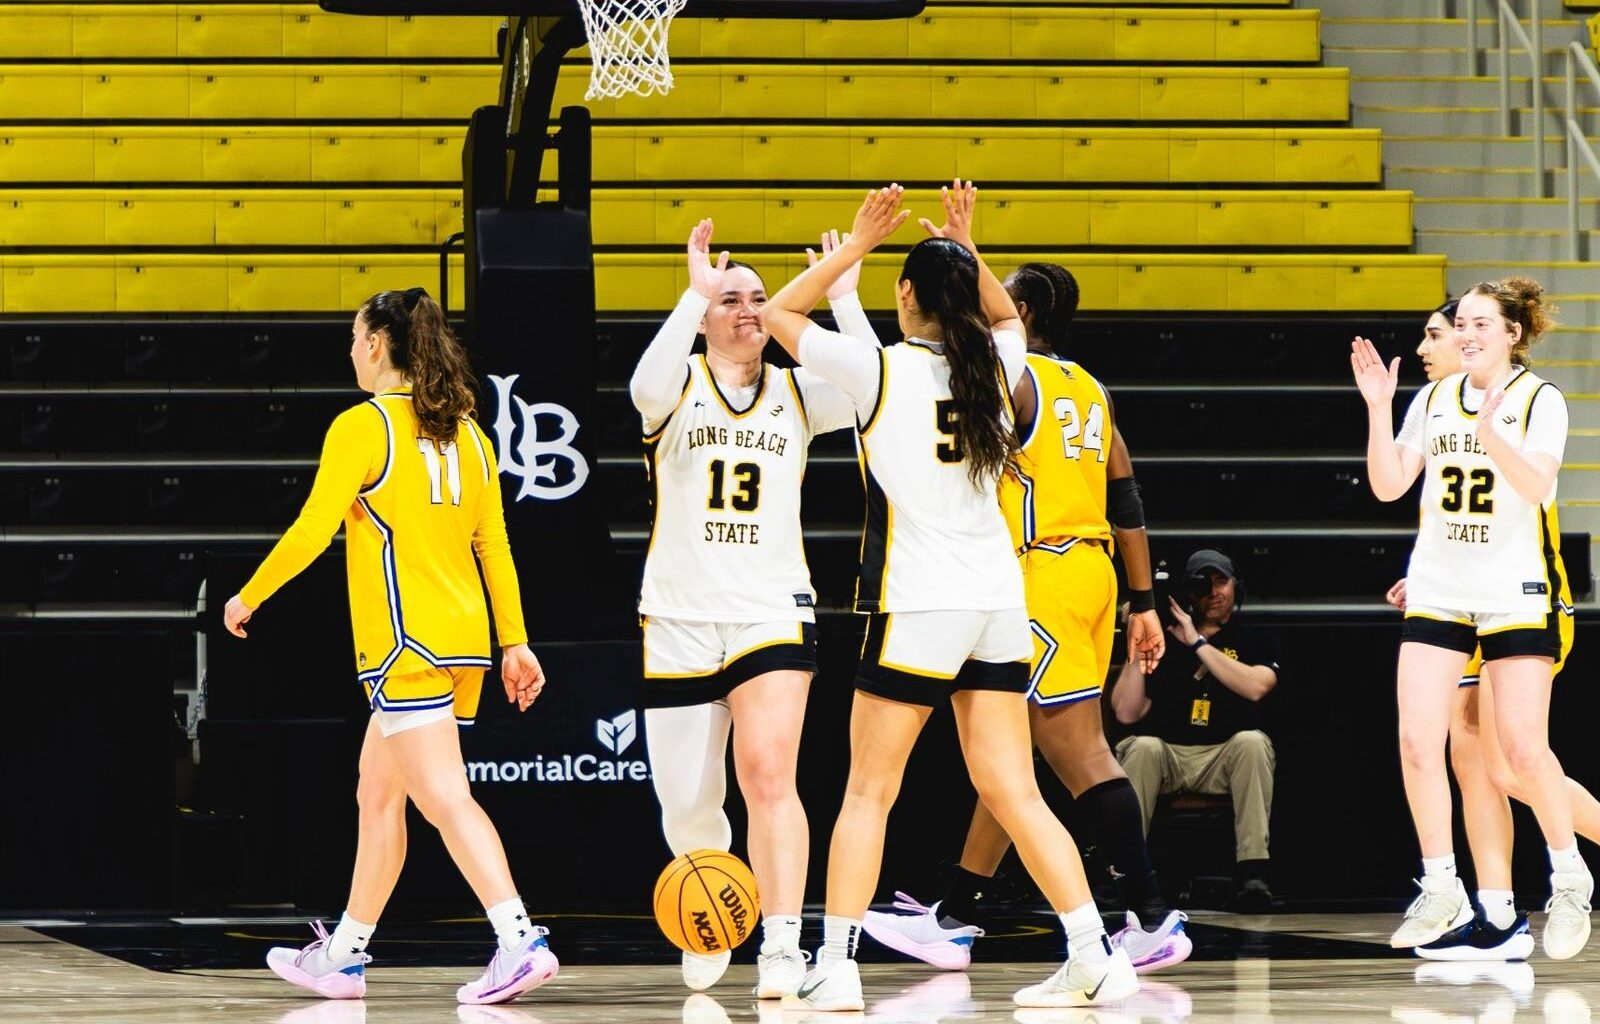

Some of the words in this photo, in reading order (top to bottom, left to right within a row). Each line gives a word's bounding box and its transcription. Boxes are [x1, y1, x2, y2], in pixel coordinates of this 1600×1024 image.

[688, 426, 728, 450] LONG
[735, 430, 787, 456] BEACH
[935, 399, 967, 463] 5
[1053, 397, 1105, 463] 24
[1431, 433, 1457, 456] ONG
[416, 436, 461, 507] 11
[708, 458, 761, 512] 13
[1441, 466, 1495, 514] 32
[705, 521, 759, 544] STATE
[465, 754, 647, 782] morialCare
[692, 911, 721, 951] NCAA
